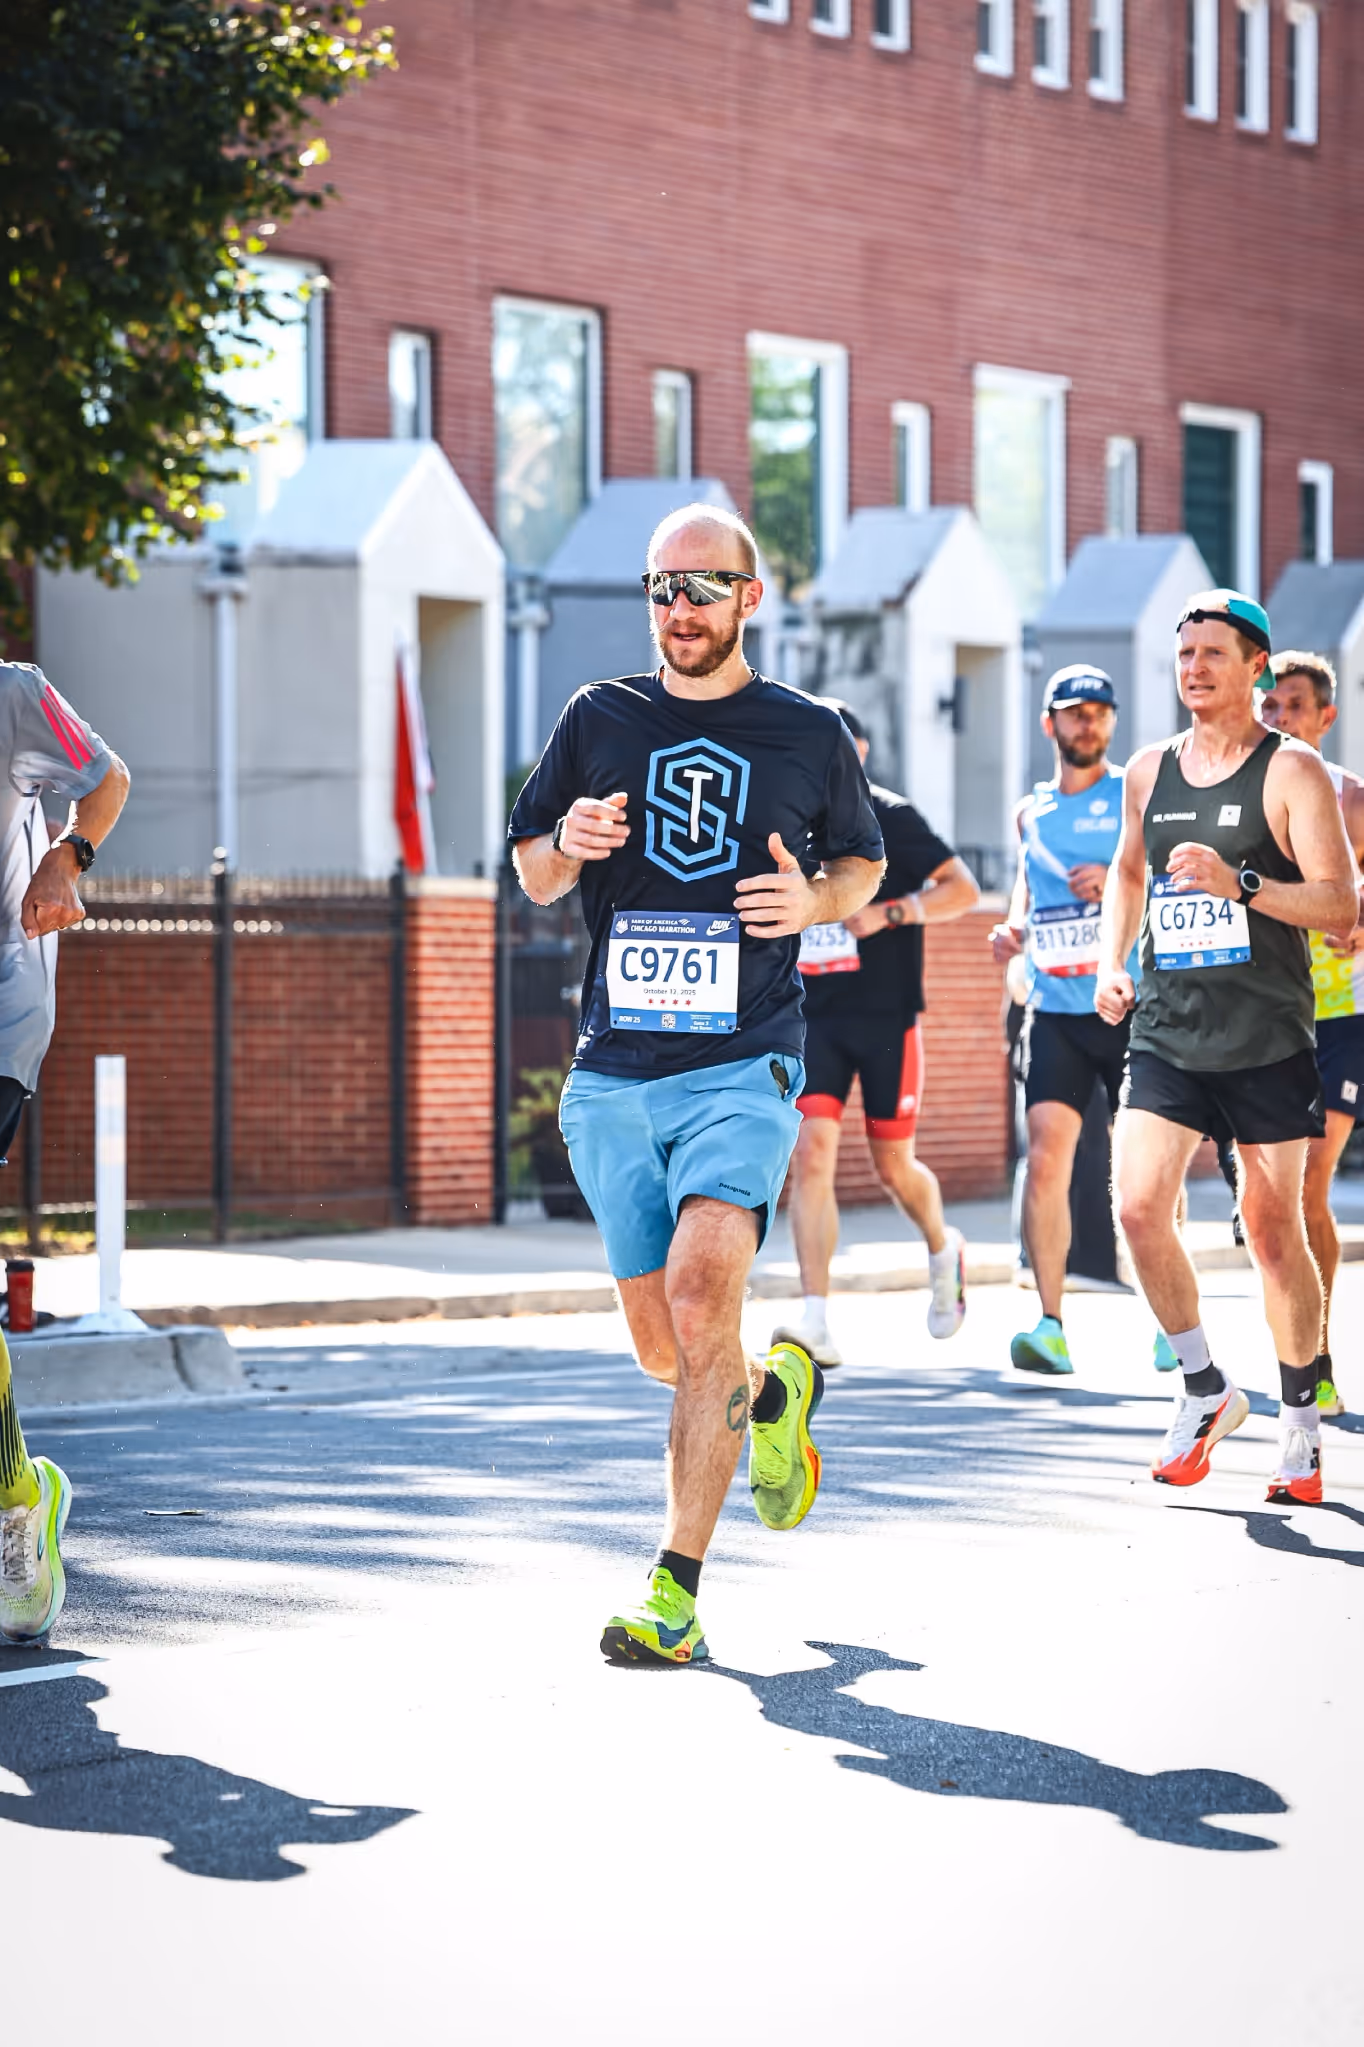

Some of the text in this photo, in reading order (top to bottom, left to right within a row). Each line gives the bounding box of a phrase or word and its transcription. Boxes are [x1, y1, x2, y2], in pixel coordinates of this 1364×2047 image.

[1160, 899, 1234, 931] C6734
[710, 920, 731, 930] RUN
[658, 926, 696, 934] MARATHON
[620, 946, 718, 984] C9761
[669, 988, 679, 996] 12,
[633, 1016, 641, 1024] 25
[717, 1019, 727, 1027] 16
